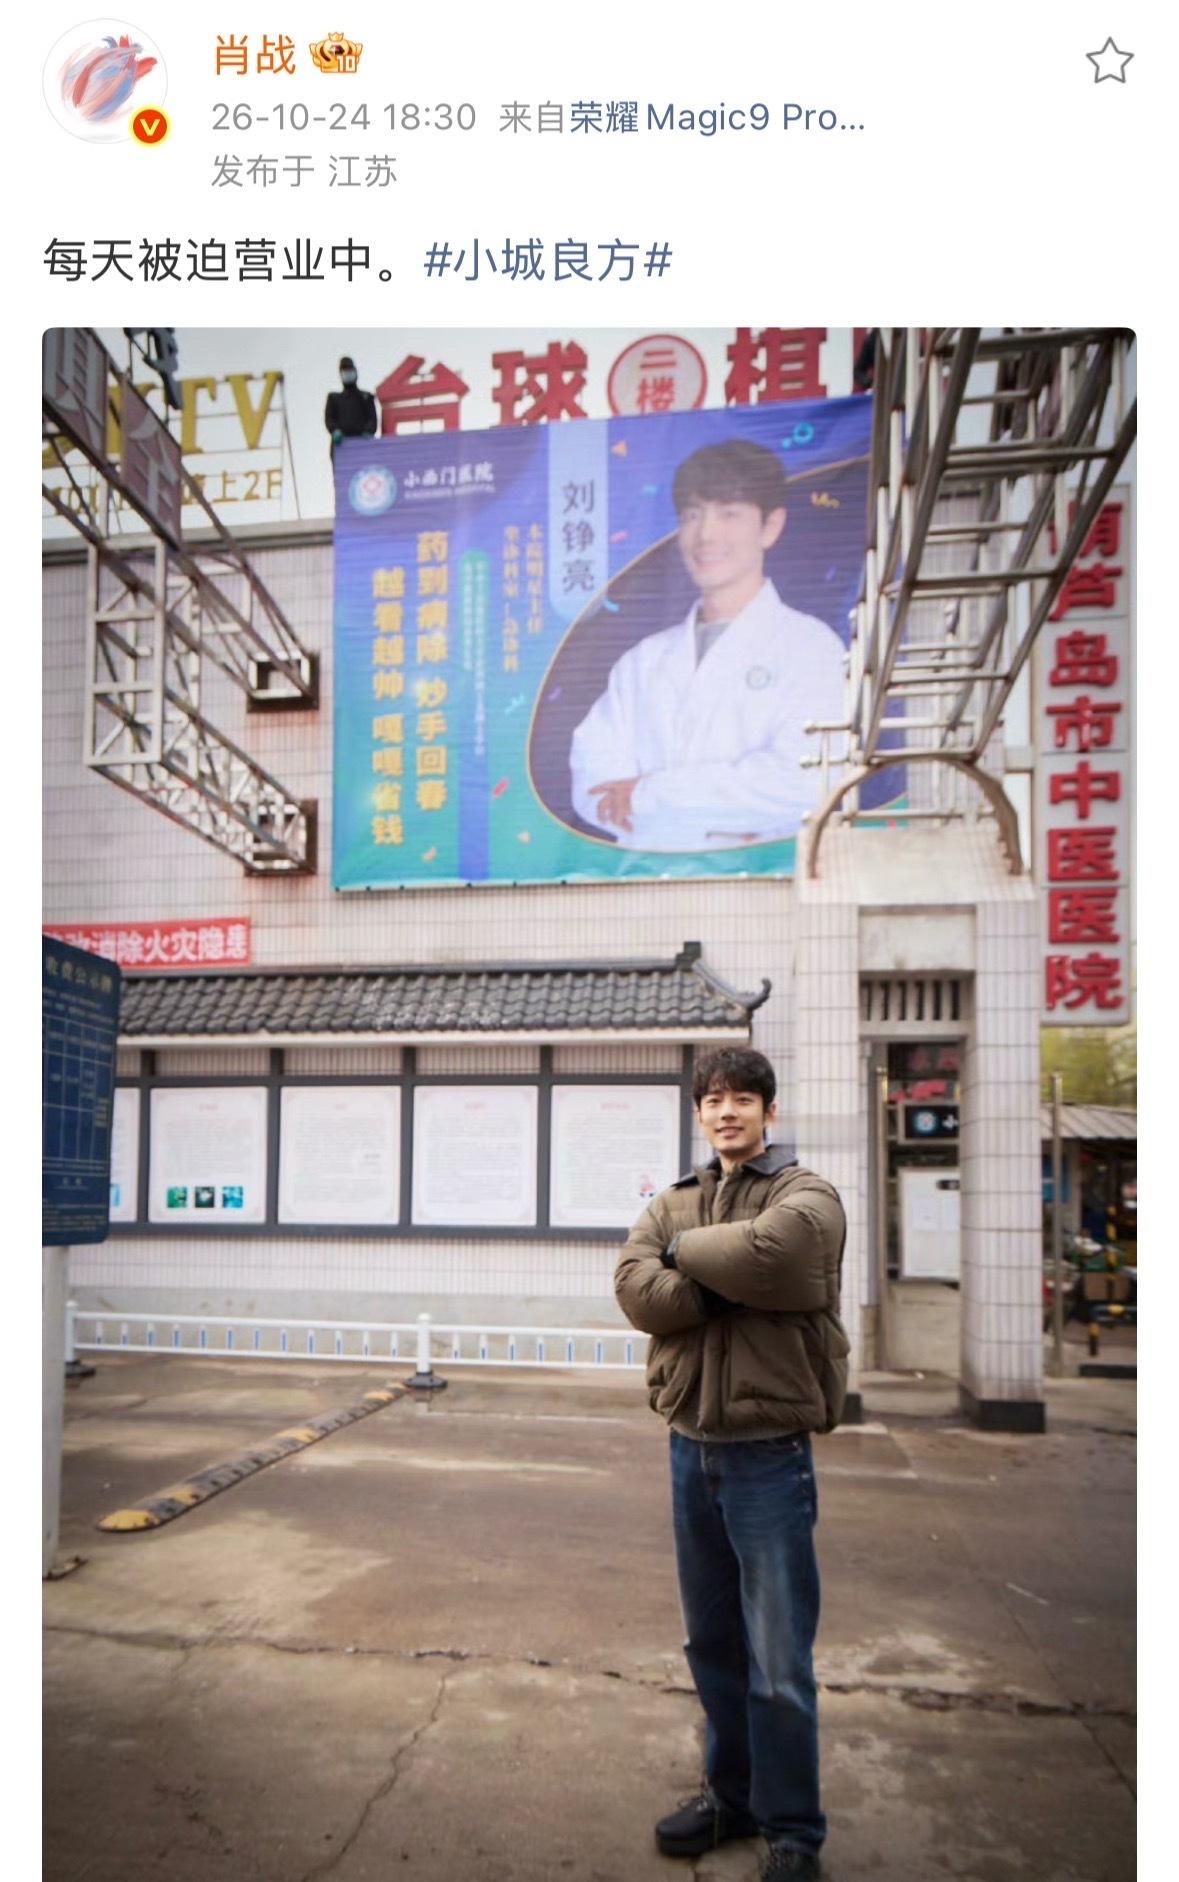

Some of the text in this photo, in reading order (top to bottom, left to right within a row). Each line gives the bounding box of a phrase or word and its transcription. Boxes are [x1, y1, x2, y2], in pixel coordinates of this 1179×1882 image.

[724, 328, 868, 409] 棋
[562, 479, 595, 593] 刘铮亮
[43, 924, 248, 965] 改消除火灾隐患
